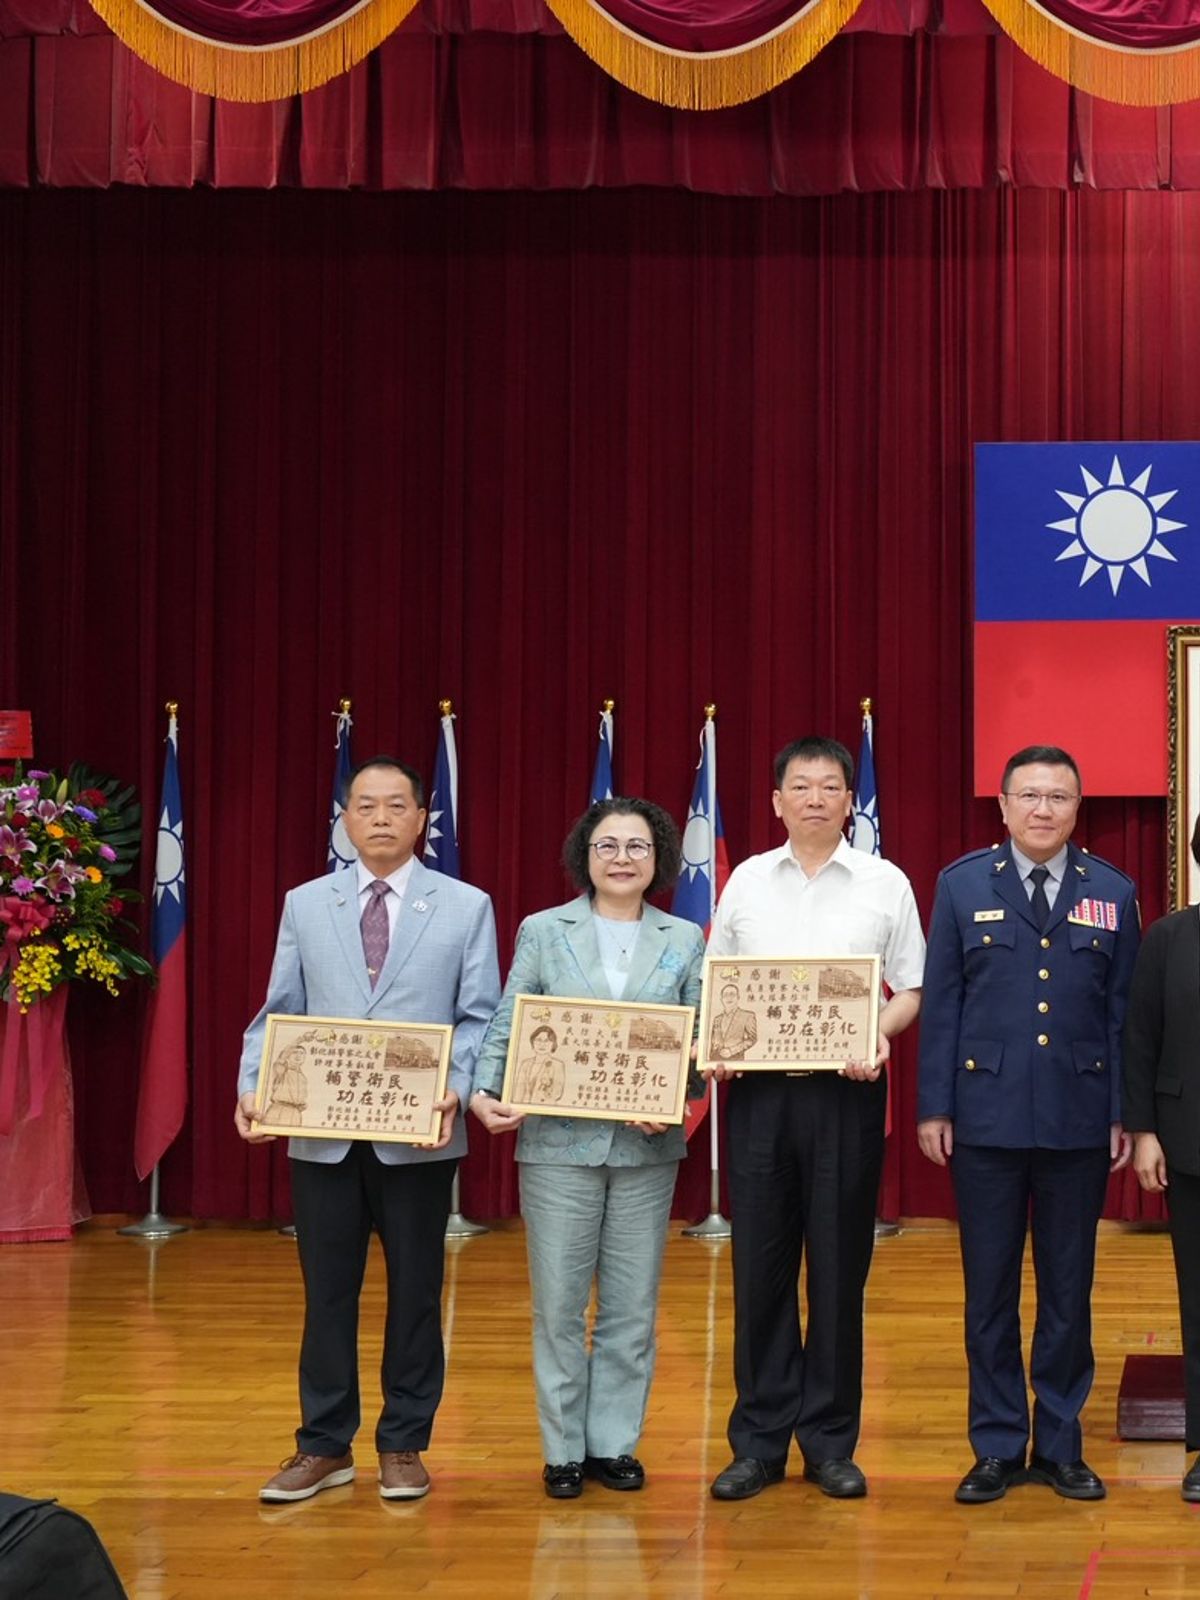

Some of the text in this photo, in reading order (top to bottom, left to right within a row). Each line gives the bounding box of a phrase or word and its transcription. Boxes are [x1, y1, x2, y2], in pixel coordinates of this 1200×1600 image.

[778, 1022, 857, 1037] 功在彰化
[590, 1069, 668, 1088] 功在彰化
[336, 1089, 420, 1108] 功在彰化
